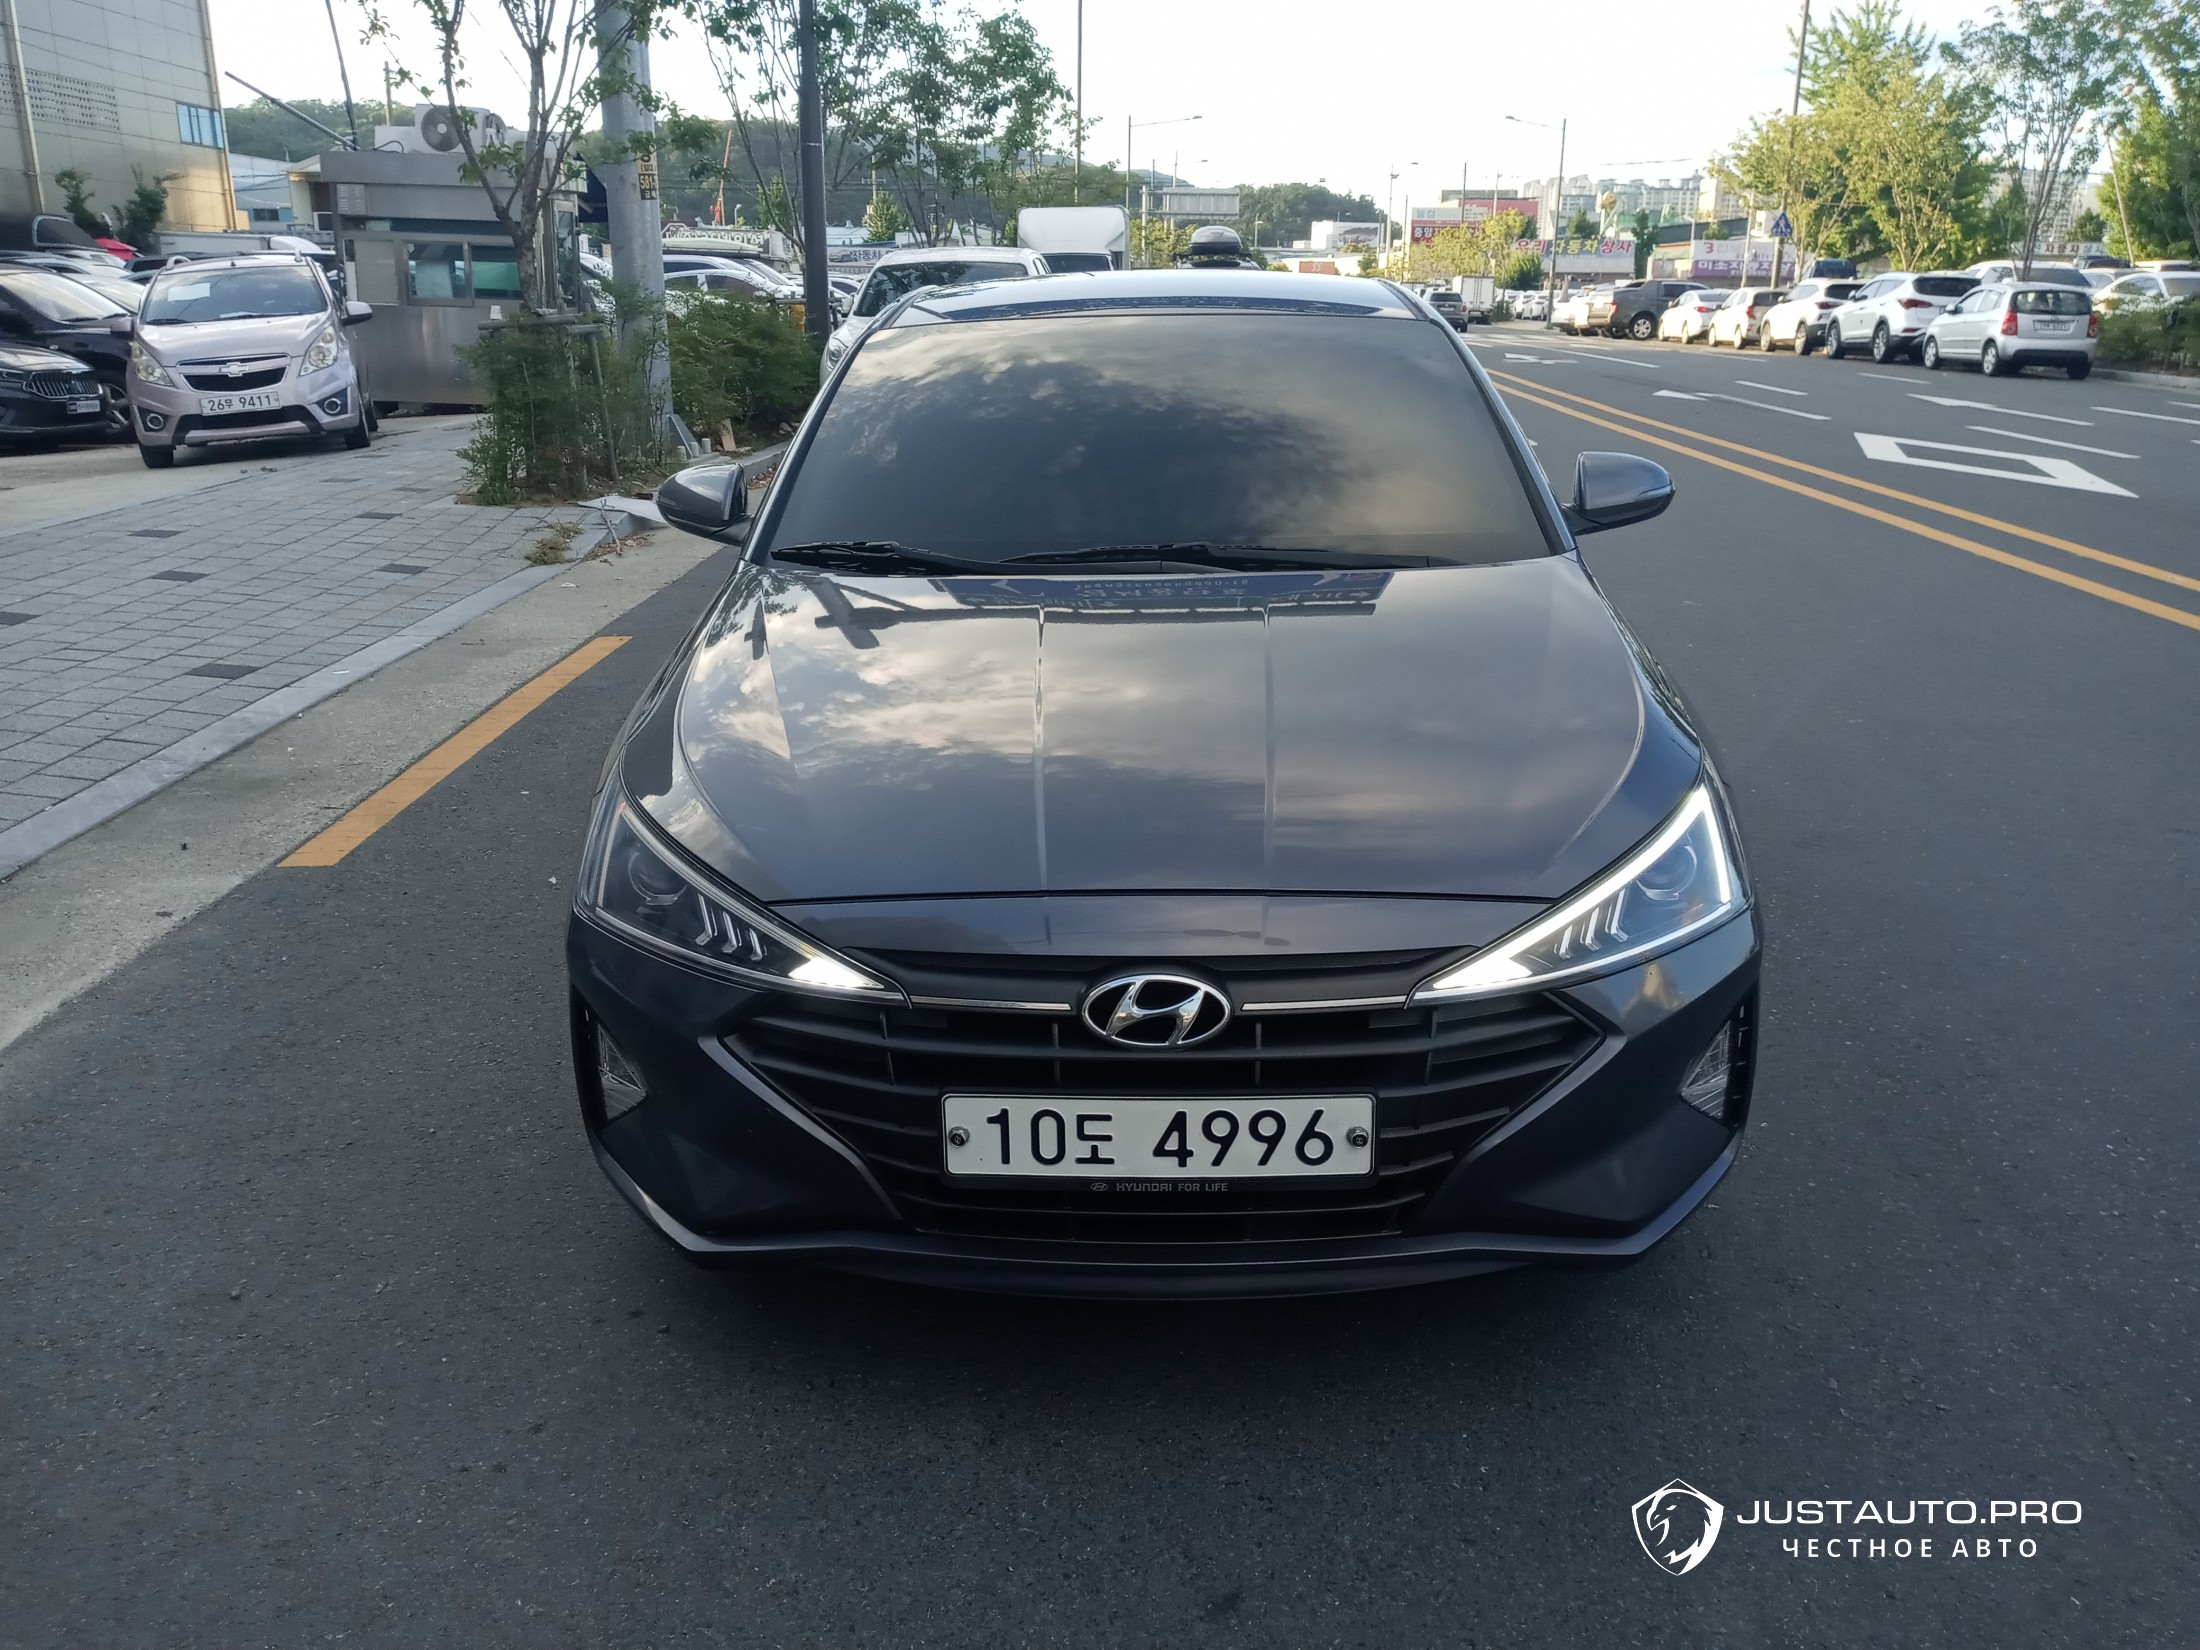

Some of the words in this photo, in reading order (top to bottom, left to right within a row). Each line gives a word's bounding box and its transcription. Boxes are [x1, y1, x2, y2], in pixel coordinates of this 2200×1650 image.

[239, 395, 272, 409] 9411
[986, 1107, 1116, 1166] 10도
[1152, 1108, 1335, 1167] 4996
[1116, 1182, 1172, 1192] HYUNDAI
[1178, 1182, 1200, 1192] FOR
[1204, 1182, 1228, 1192] LIFE
